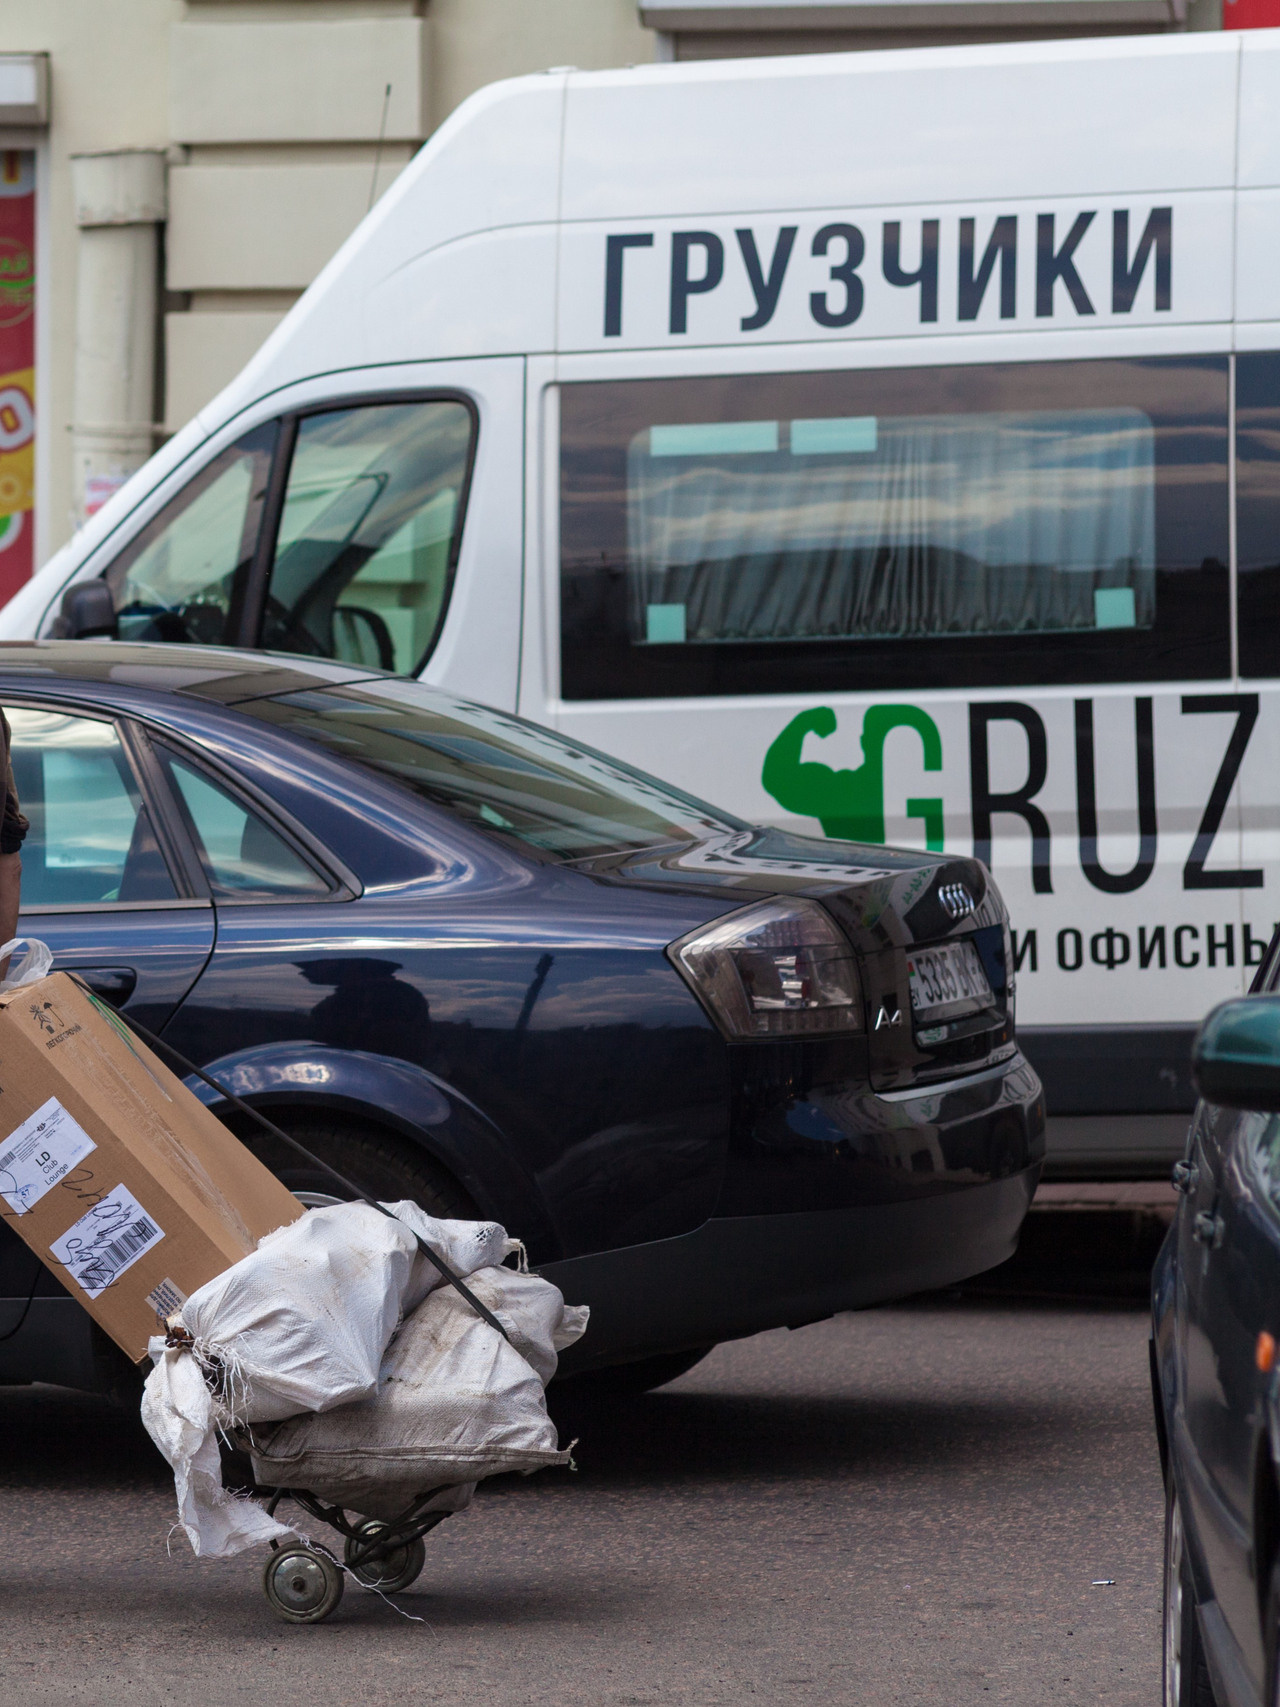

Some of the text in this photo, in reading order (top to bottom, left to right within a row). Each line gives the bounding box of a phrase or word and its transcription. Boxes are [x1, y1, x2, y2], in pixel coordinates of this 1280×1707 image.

[603, 205, 1173, 338] ГРУЗЧИКИ
[35, 1151, 51, 1167] LD
[42, 1159, 59, 1174] Club
[44, 1163, 69, 1186] Lounge
